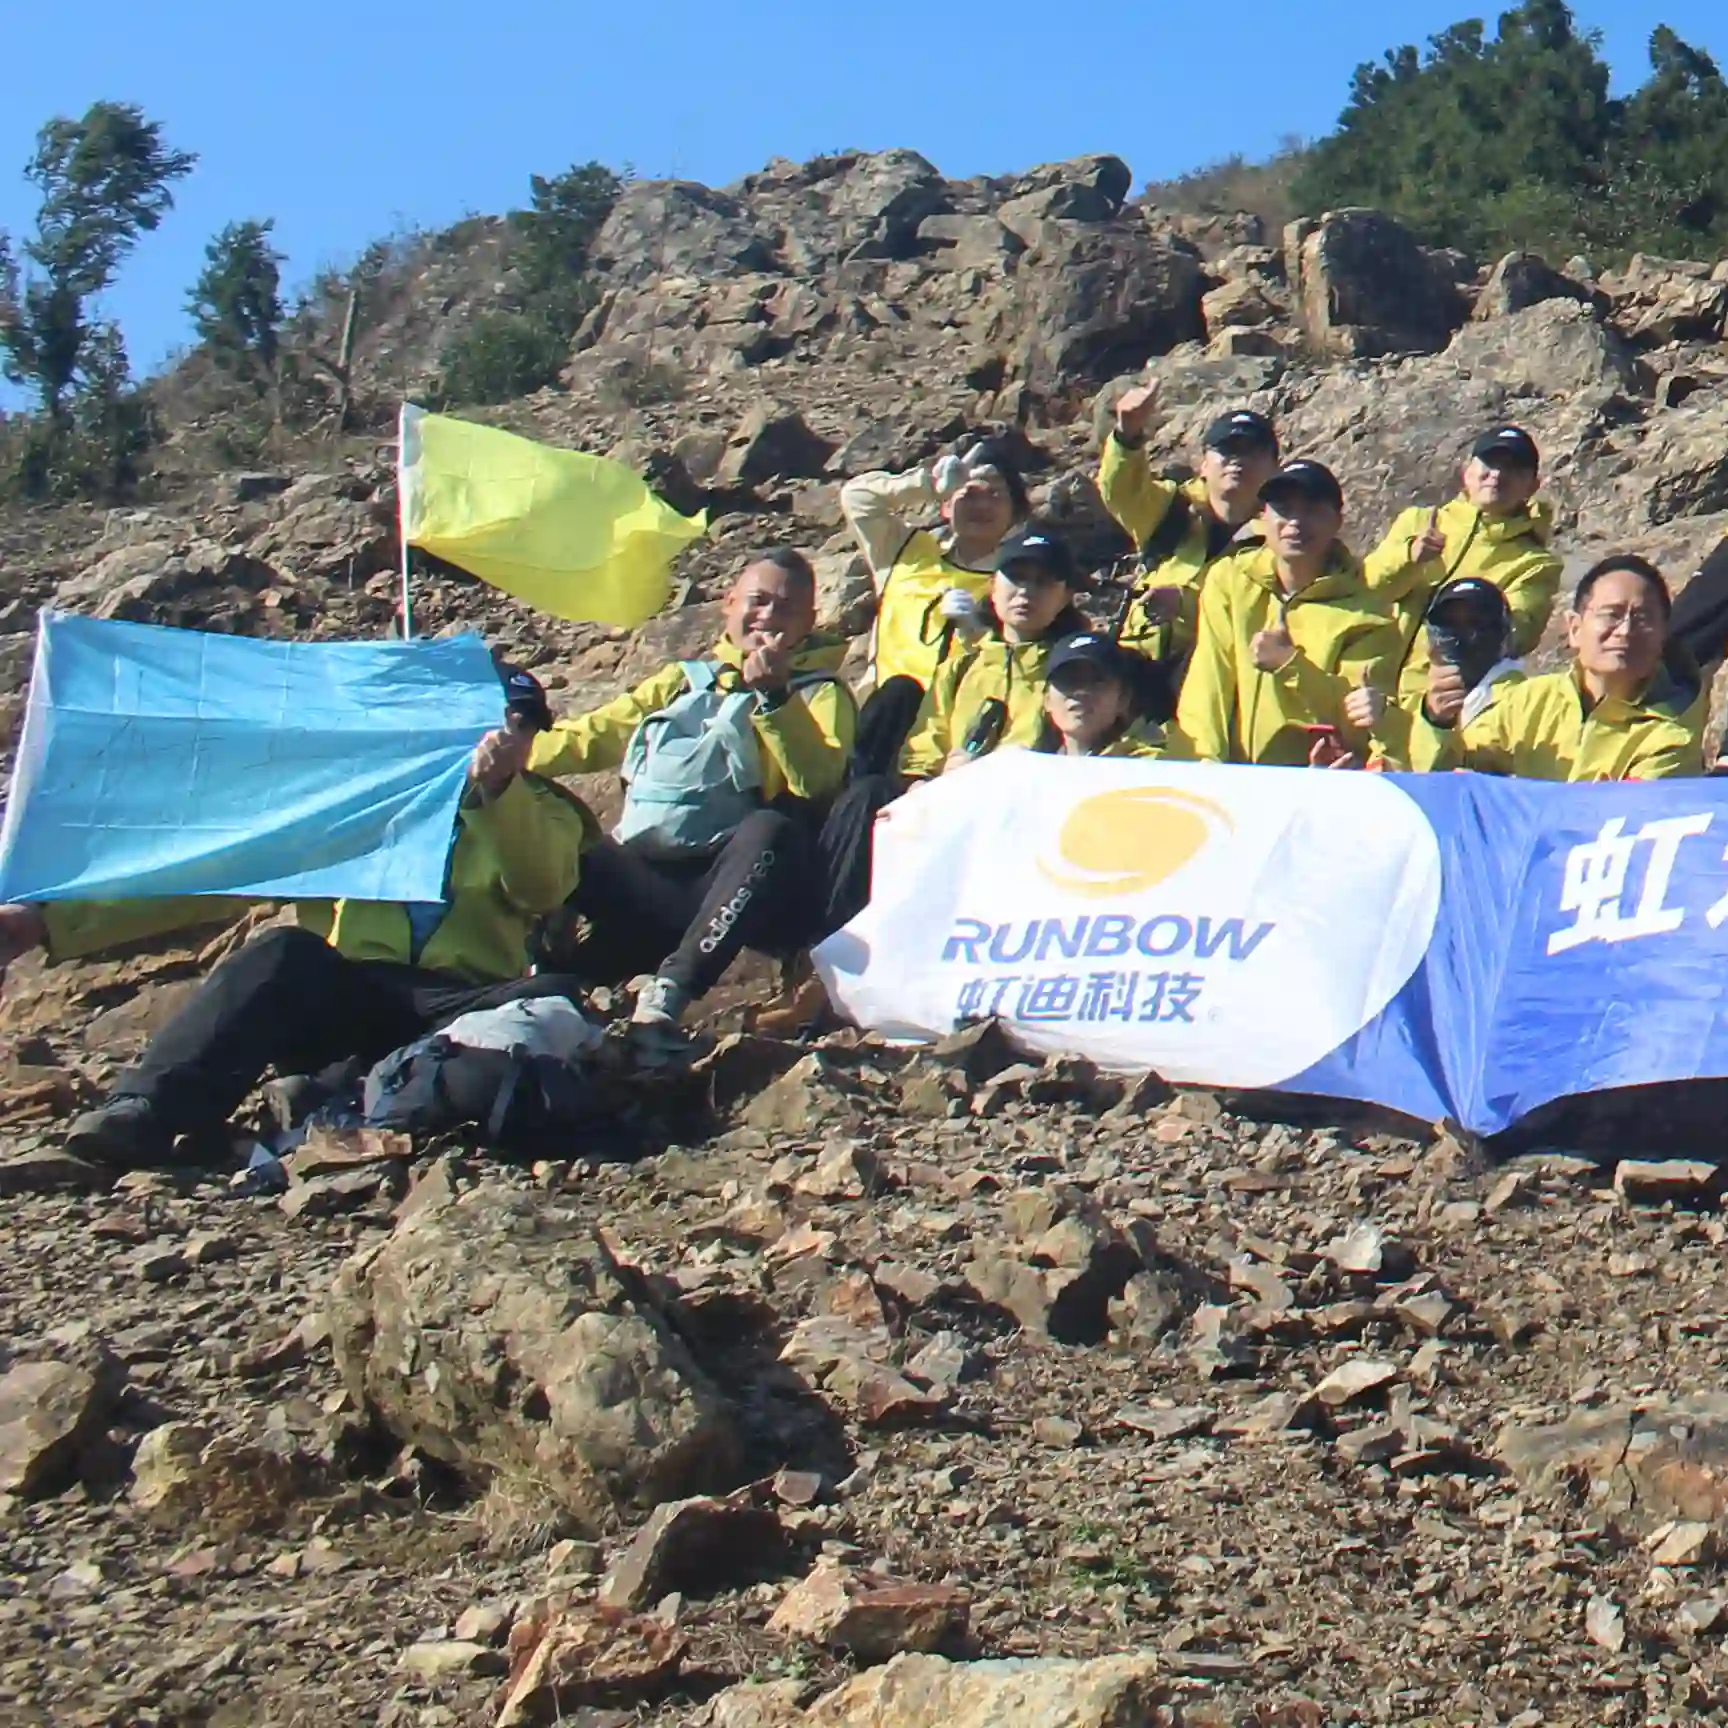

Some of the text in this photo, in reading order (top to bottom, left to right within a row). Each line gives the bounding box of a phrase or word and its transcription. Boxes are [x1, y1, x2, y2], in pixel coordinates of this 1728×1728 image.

[700, 887, 753, 953] adidas
[941, 914, 1276, 963] RUNBOW
[954, 971, 1206, 1023] 虹迪科技
